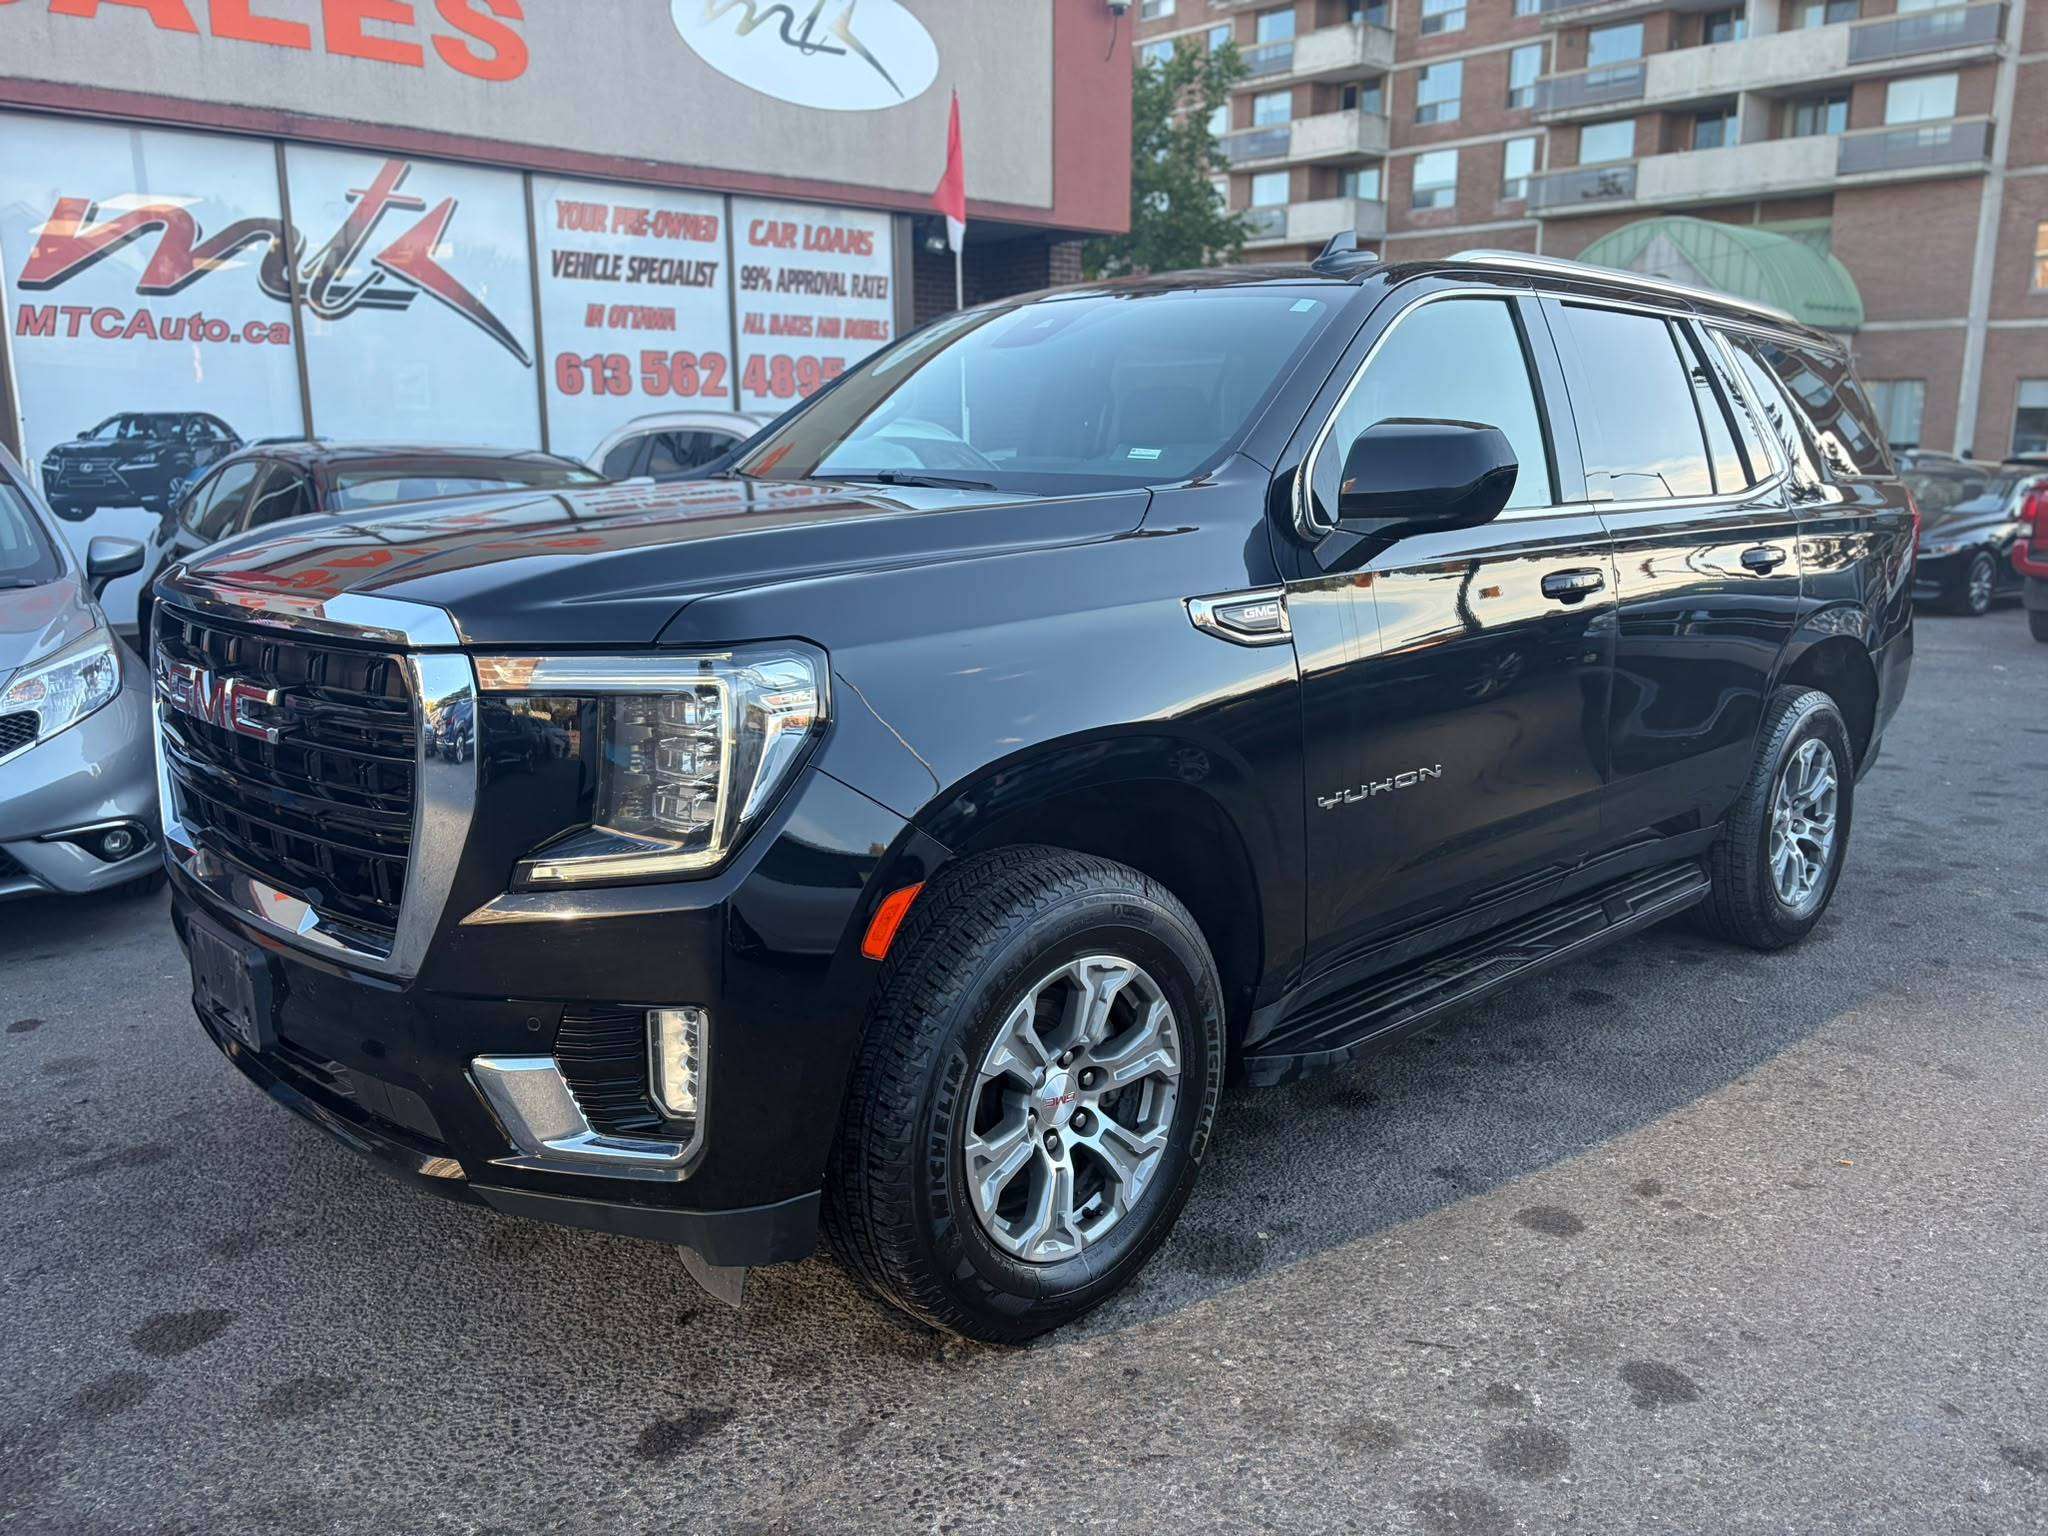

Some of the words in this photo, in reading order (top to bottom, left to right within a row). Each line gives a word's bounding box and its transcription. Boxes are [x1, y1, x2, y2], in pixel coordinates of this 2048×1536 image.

[556, 200, 608, 233] YOUR
[611, 206, 719, 243] PRE-OWNED
[748, 219, 798, 249] CAR
[803, 224, 875, 257] LOANS
[551, 250, 623, 281] VEHICLE
[626, 256, 719, 288] SPECIALIST
[739, 265, 772, 292] 99%
[776, 267, 848, 297] APPROVAL
[851, 274, 889, 300] RATE!
[15, 304, 291, 345] MTCAuto.ca
[585, 303, 606, 328] IN
[608, 304, 677, 331] OTTAWA
[743, 312, 767, 335] ALL
[555, 351, 632, 396] 613
[640, 349, 728, 397] 562
[1244, 603, 1278, 618] GMC
[167, 660, 281, 745] GMC
[1316, 764, 1442, 810] YUKON
[1043, 1090, 1077, 1108] GMC
